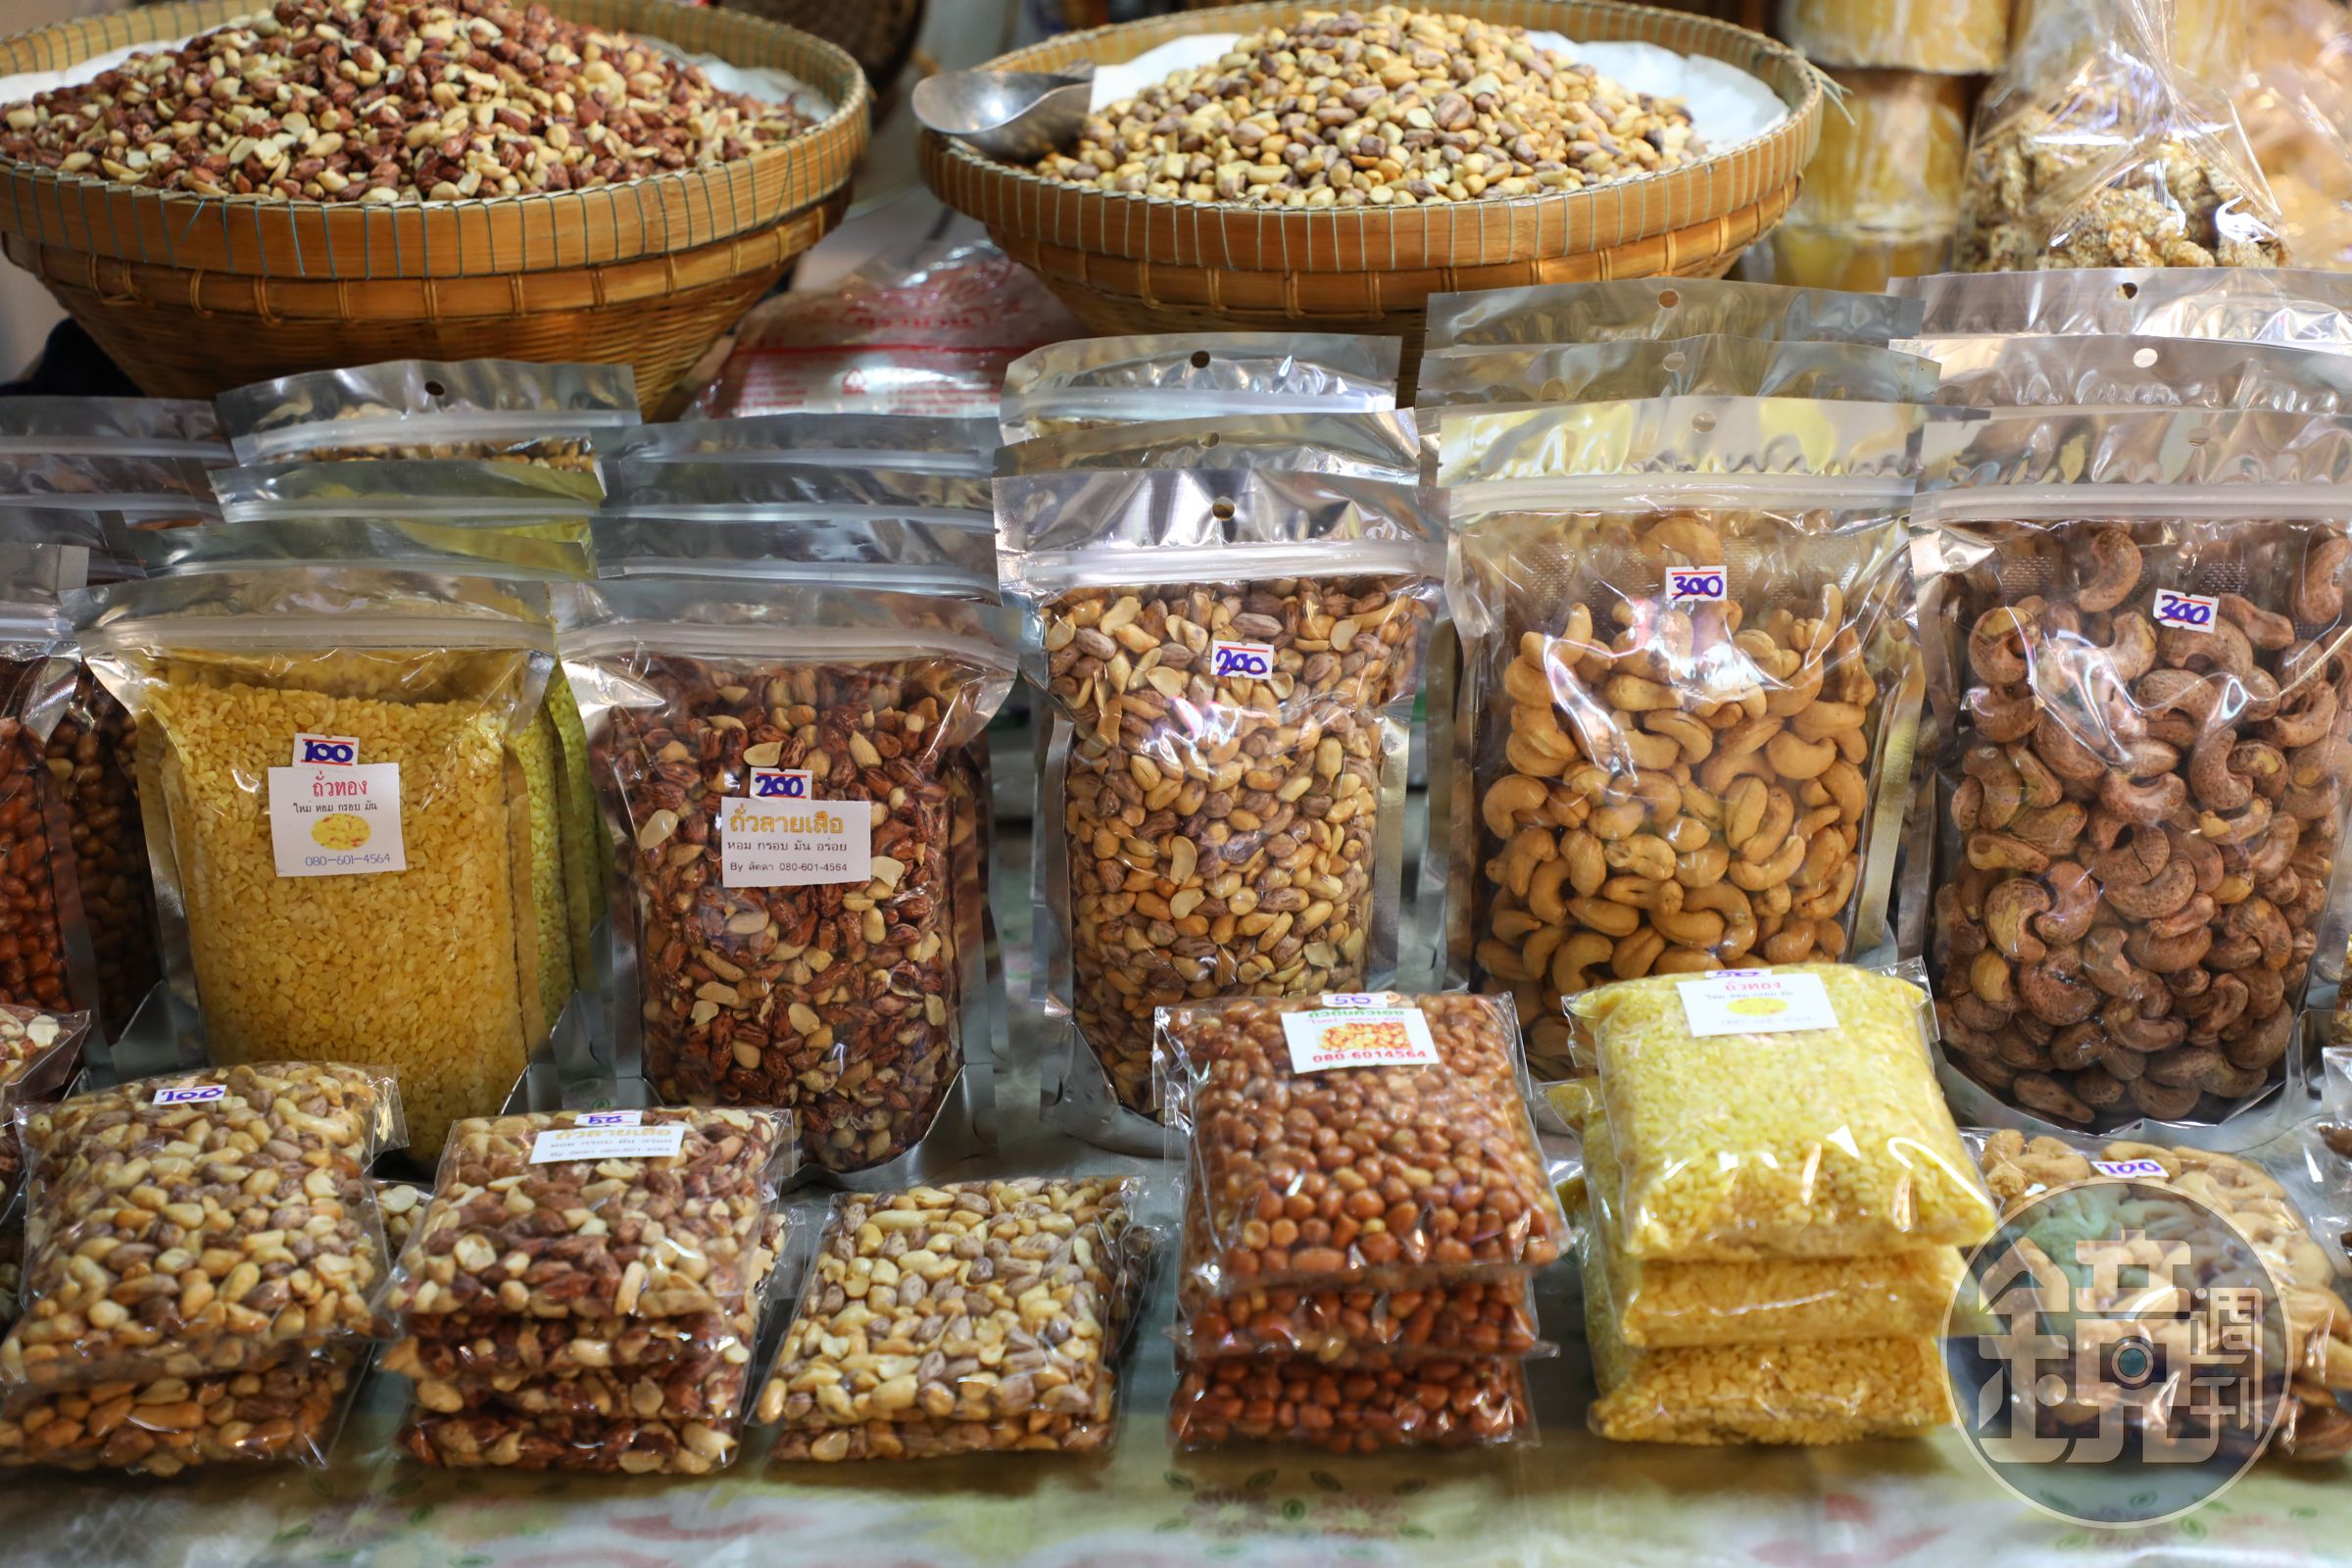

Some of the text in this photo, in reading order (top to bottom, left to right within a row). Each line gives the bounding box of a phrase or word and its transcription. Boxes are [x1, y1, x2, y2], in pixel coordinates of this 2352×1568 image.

[1673, 575, 1724, 600] 300
[2157, 594, 2211, 624] 300
[1216, 649, 1268, 676] 200
[305, 740, 354, 762] 100
[313, 771, 368, 797] ถั่วทอง
[755, 775, 804, 797] 200
[316, 804, 334, 812] หอม
[338, 804, 361, 812] กรอบ
[365, 800, 378, 810] มัน
[730, 804, 844, 834] ถั่วลายเสือ
[727, 837, 848, 852] หอม กรอบ มัน อร่อย
[305, 854, 391, 866] 080-601-4564
[730, 863, 743, 873] By
[1334, 996, 1371, 1005] 50
[162, 1088, 223, 1102] 100
[2097, 1161, 2161, 1174] 100
